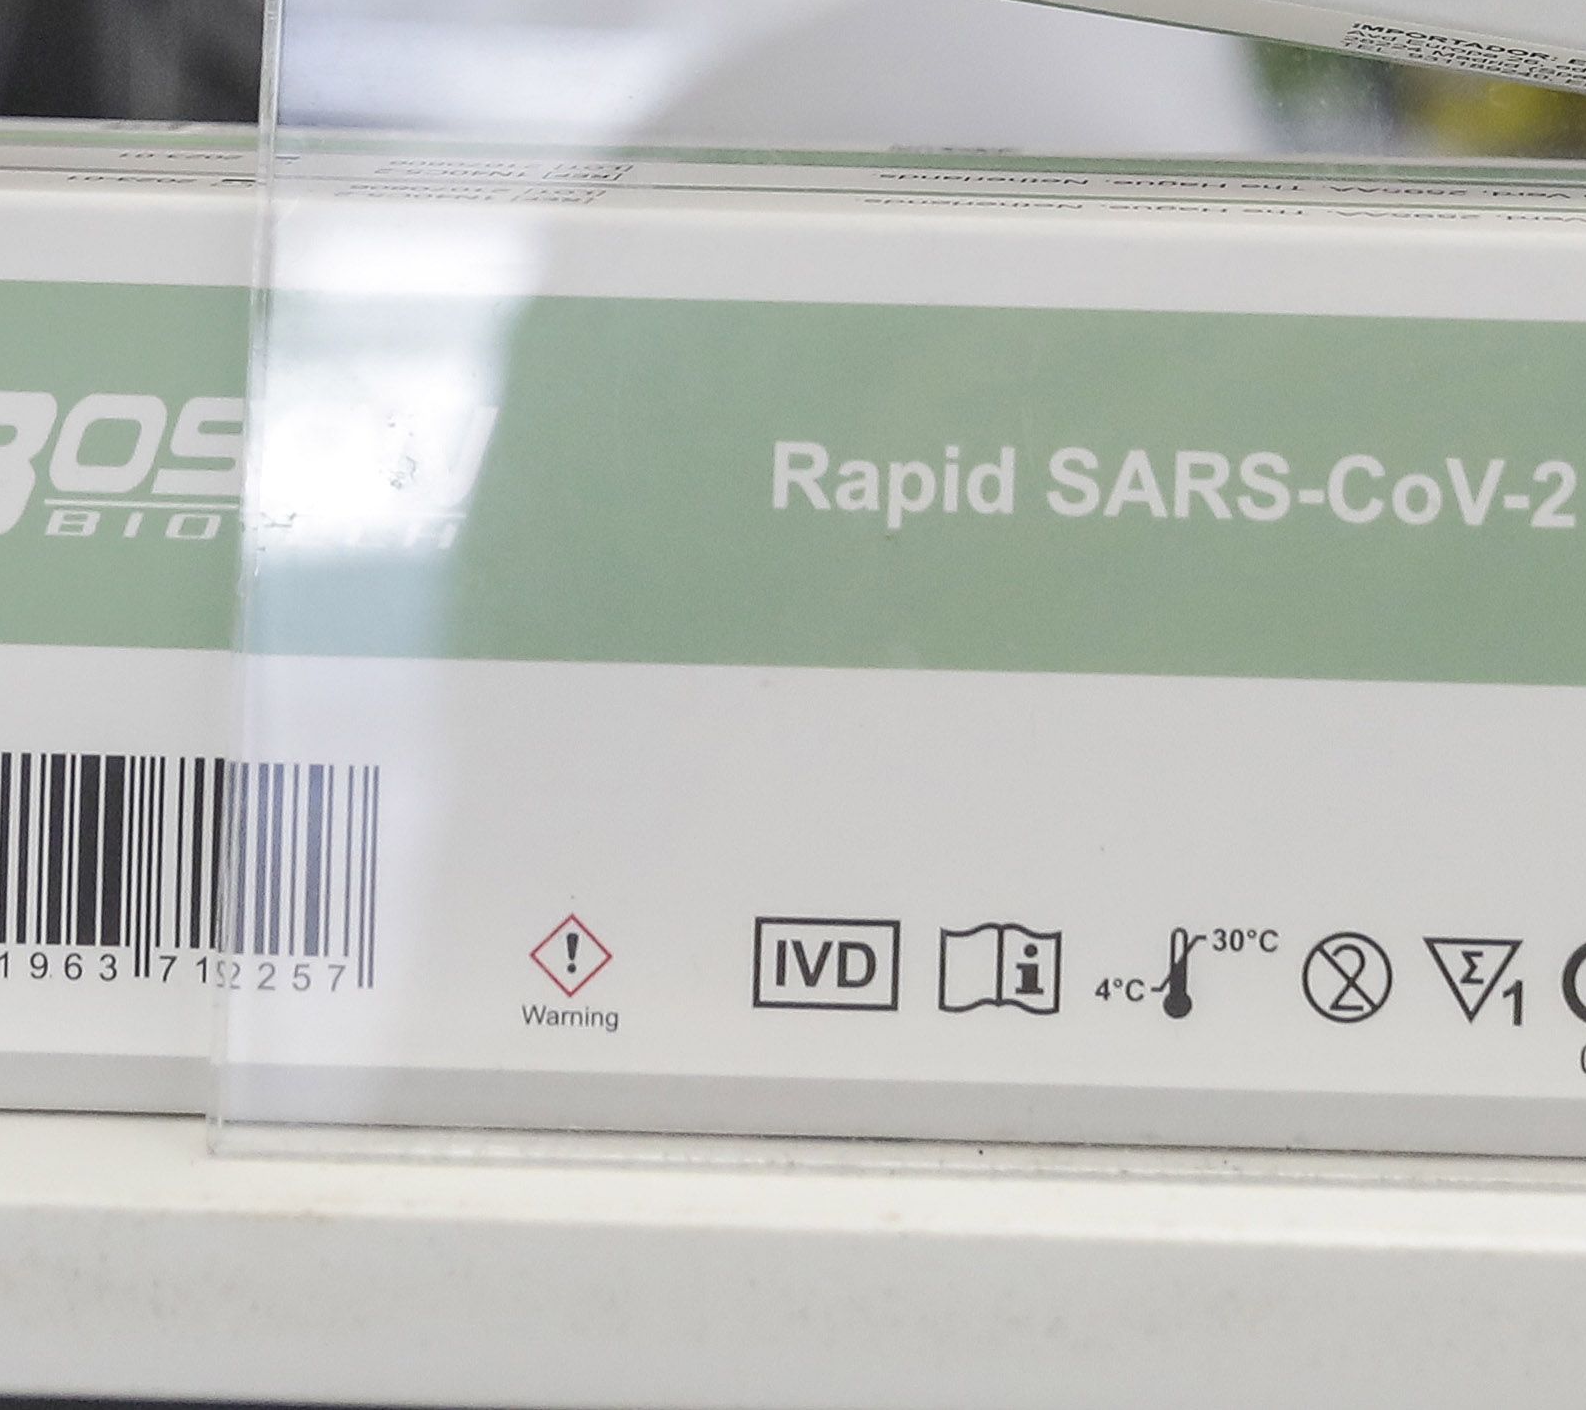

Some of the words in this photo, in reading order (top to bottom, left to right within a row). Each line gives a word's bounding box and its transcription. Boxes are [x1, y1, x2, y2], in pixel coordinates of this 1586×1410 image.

[1352, 22, 1557, 61] IMPORTADOR:
[1405, 38, 1499, 60] Europa
[1430, 49, 1520, 69] Madrid
[771, 441, 1015, 529] Rapid
[1047, 448, 1578, 529] SARS-CoV-2
[775, 939, 876, 988] IVD
[522, 1005, 619, 1031] Warning
